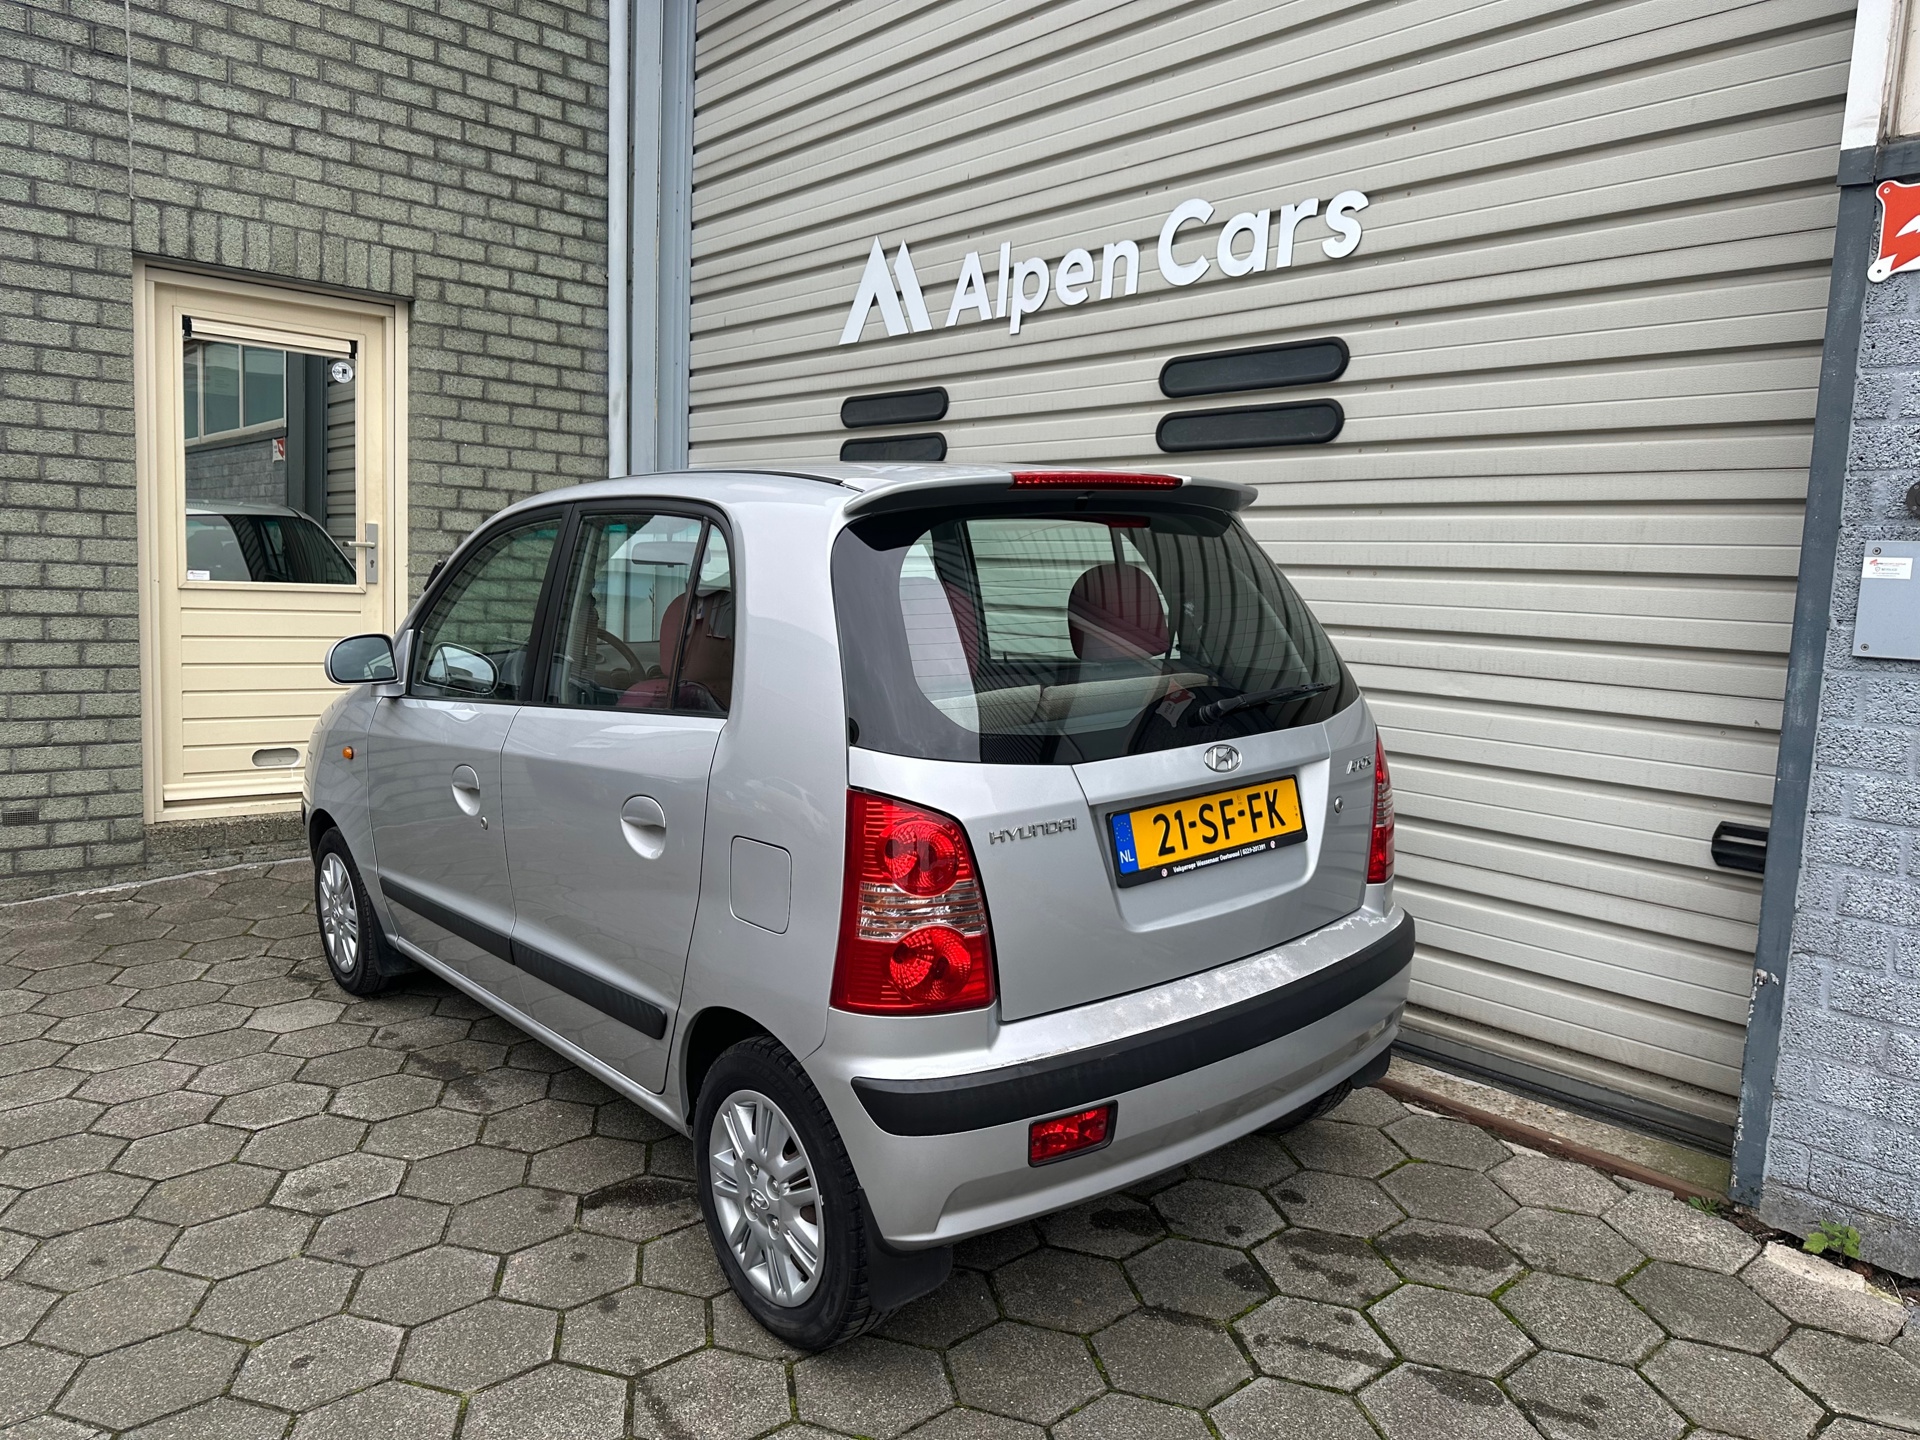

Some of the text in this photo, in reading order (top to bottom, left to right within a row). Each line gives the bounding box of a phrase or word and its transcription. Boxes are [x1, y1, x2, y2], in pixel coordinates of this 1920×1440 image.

[944, 240, 1140, 335] Alpen
[1157, 189, 1370, 287] Cars
[988, 817, 1078, 845] HYUNDAI
[1152, 788, 1287, 857] 21-SF-FK
[1119, 849, 1135, 864] NL
